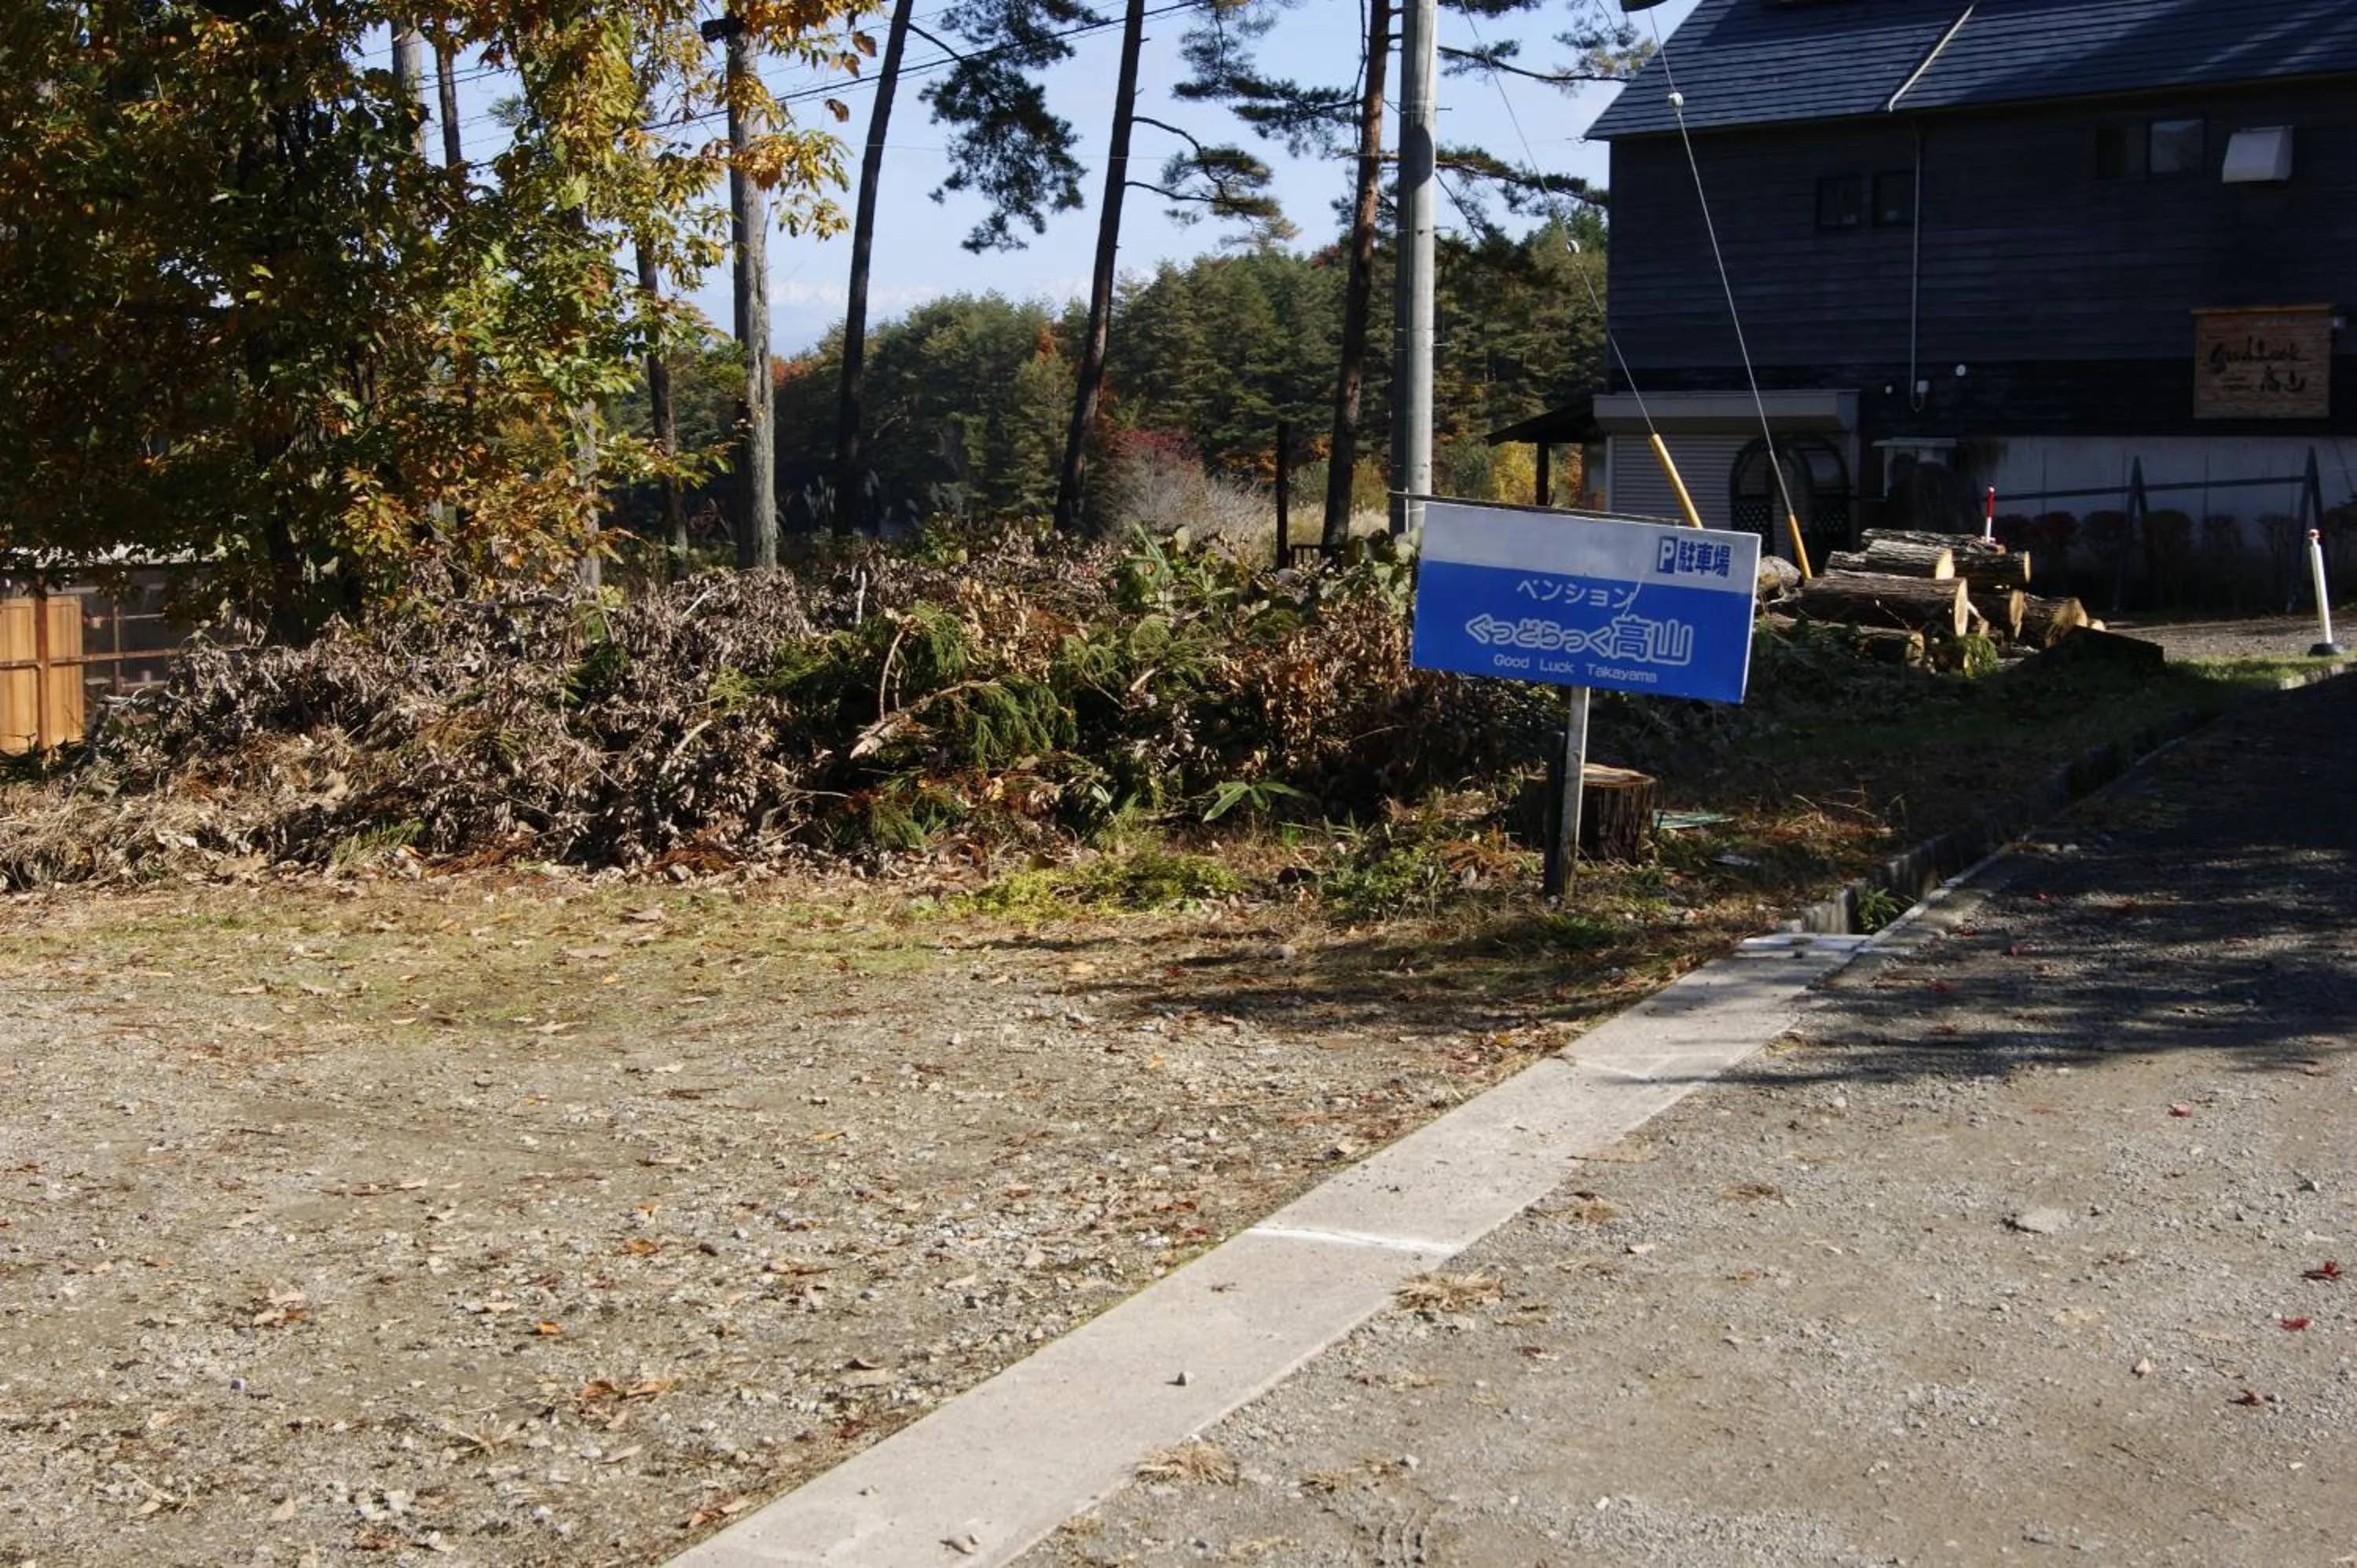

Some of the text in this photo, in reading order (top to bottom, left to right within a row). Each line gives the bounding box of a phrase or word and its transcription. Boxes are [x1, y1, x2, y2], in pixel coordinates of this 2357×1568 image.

[1516, 580, 1634, 608] ペンション
[1494, 654, 1658, 683] Good Luck Takayama
